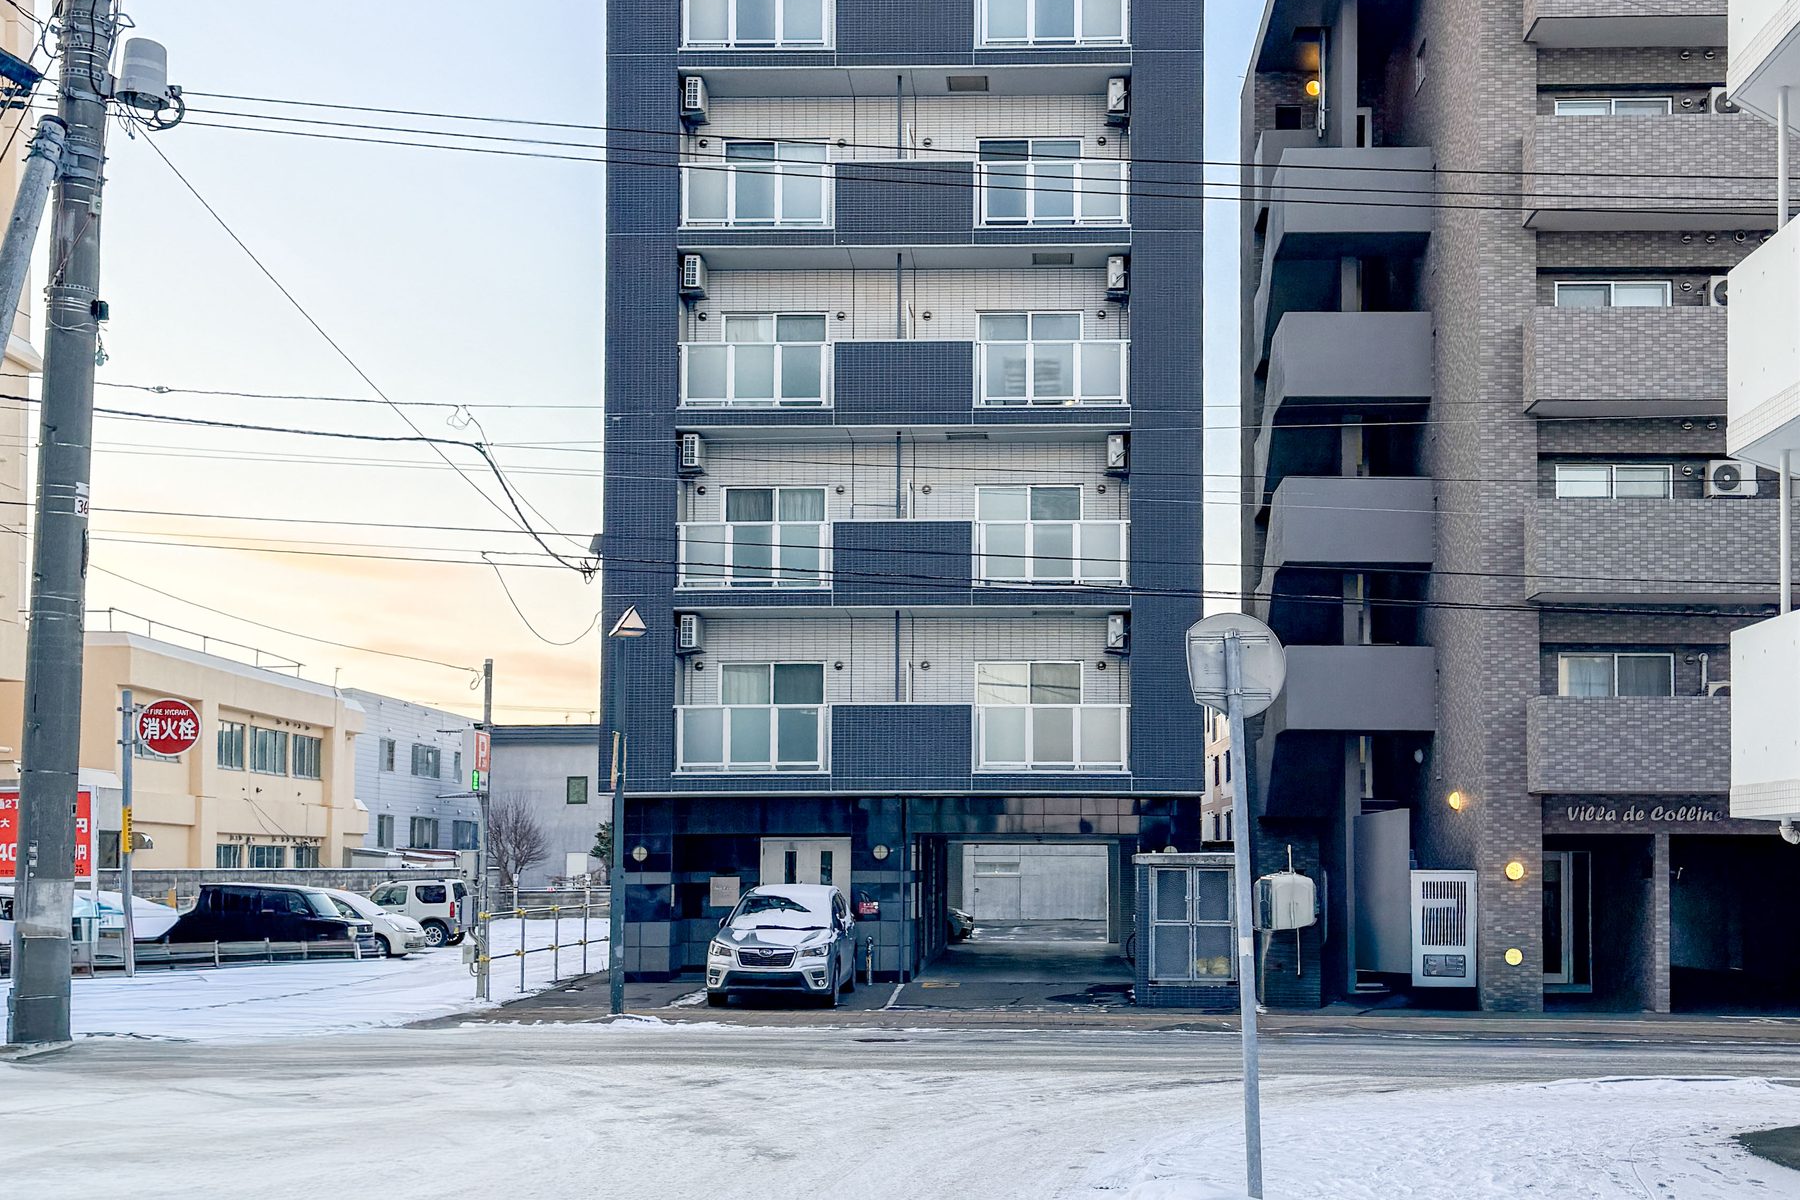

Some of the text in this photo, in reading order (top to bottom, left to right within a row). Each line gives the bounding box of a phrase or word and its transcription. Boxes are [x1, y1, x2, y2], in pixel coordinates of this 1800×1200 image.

[142, 717, 197, 741] 消火栓
[1567, 805, 1617, 822] Villa
[1622, 805, 1646, 822] de
